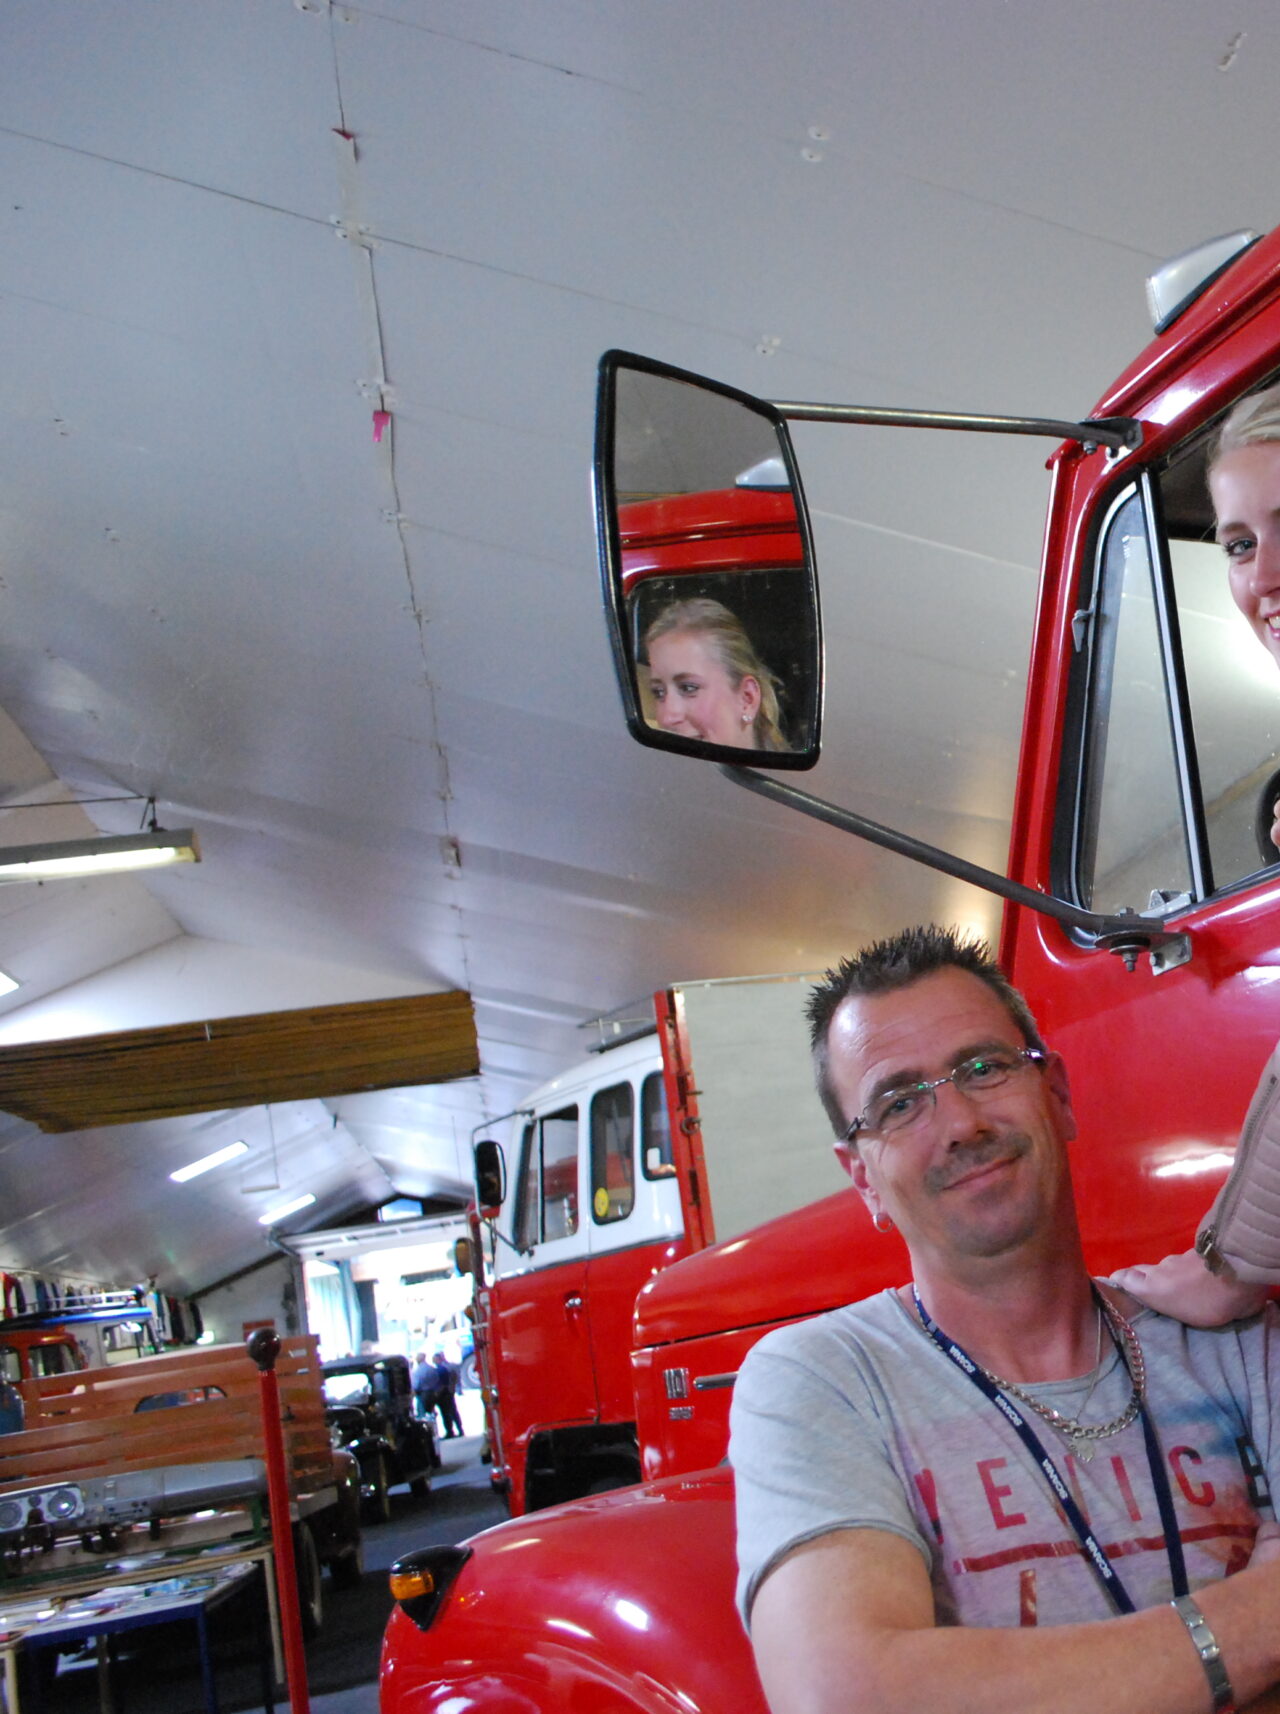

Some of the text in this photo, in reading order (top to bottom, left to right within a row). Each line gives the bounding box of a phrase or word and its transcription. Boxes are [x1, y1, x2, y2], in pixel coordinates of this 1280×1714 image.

[949, 1344, 975, 1373] SCANIA
[994, 1394, 1023, 1426] SCANIA
[1042, 1458, 1068, 1500] SCANIA
[1086, 1535, 1113, 1579] SCANIA
